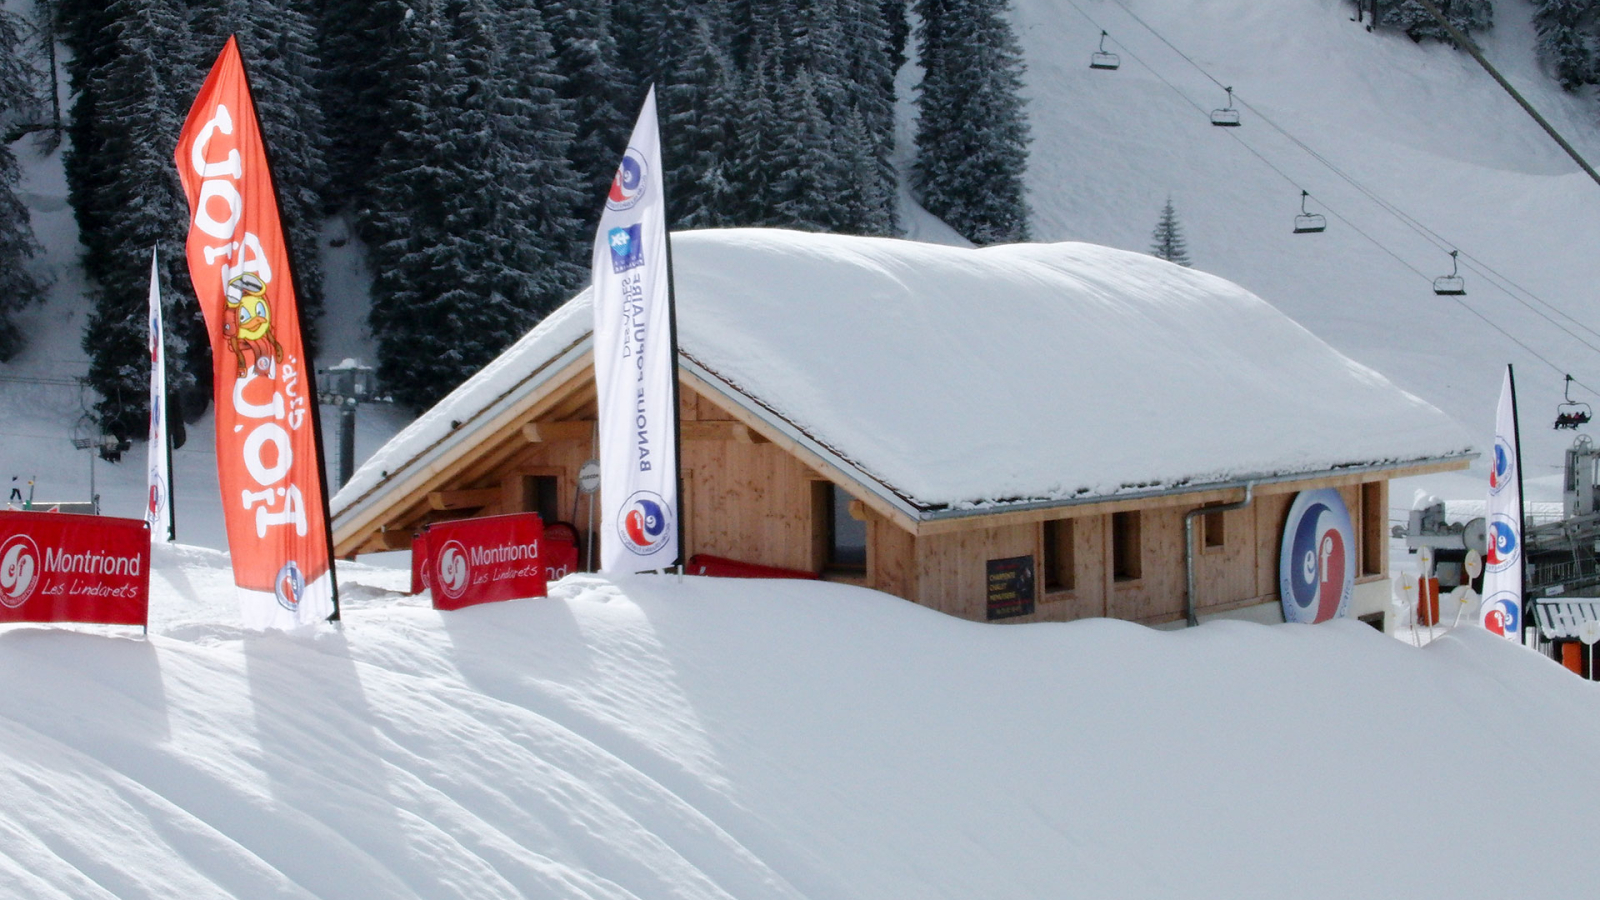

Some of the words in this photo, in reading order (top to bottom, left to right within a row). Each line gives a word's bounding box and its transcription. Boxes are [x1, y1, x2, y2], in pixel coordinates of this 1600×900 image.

[44, 547, 140, 576] Montriond
[471, 539, 538, 568] Montriond
[473, 571, 489, 585] Les
[493, 565, 538, 582] Lindarets
[41, 578, 65, 595] Les
[69, 578, 139, 598] Lindarets
